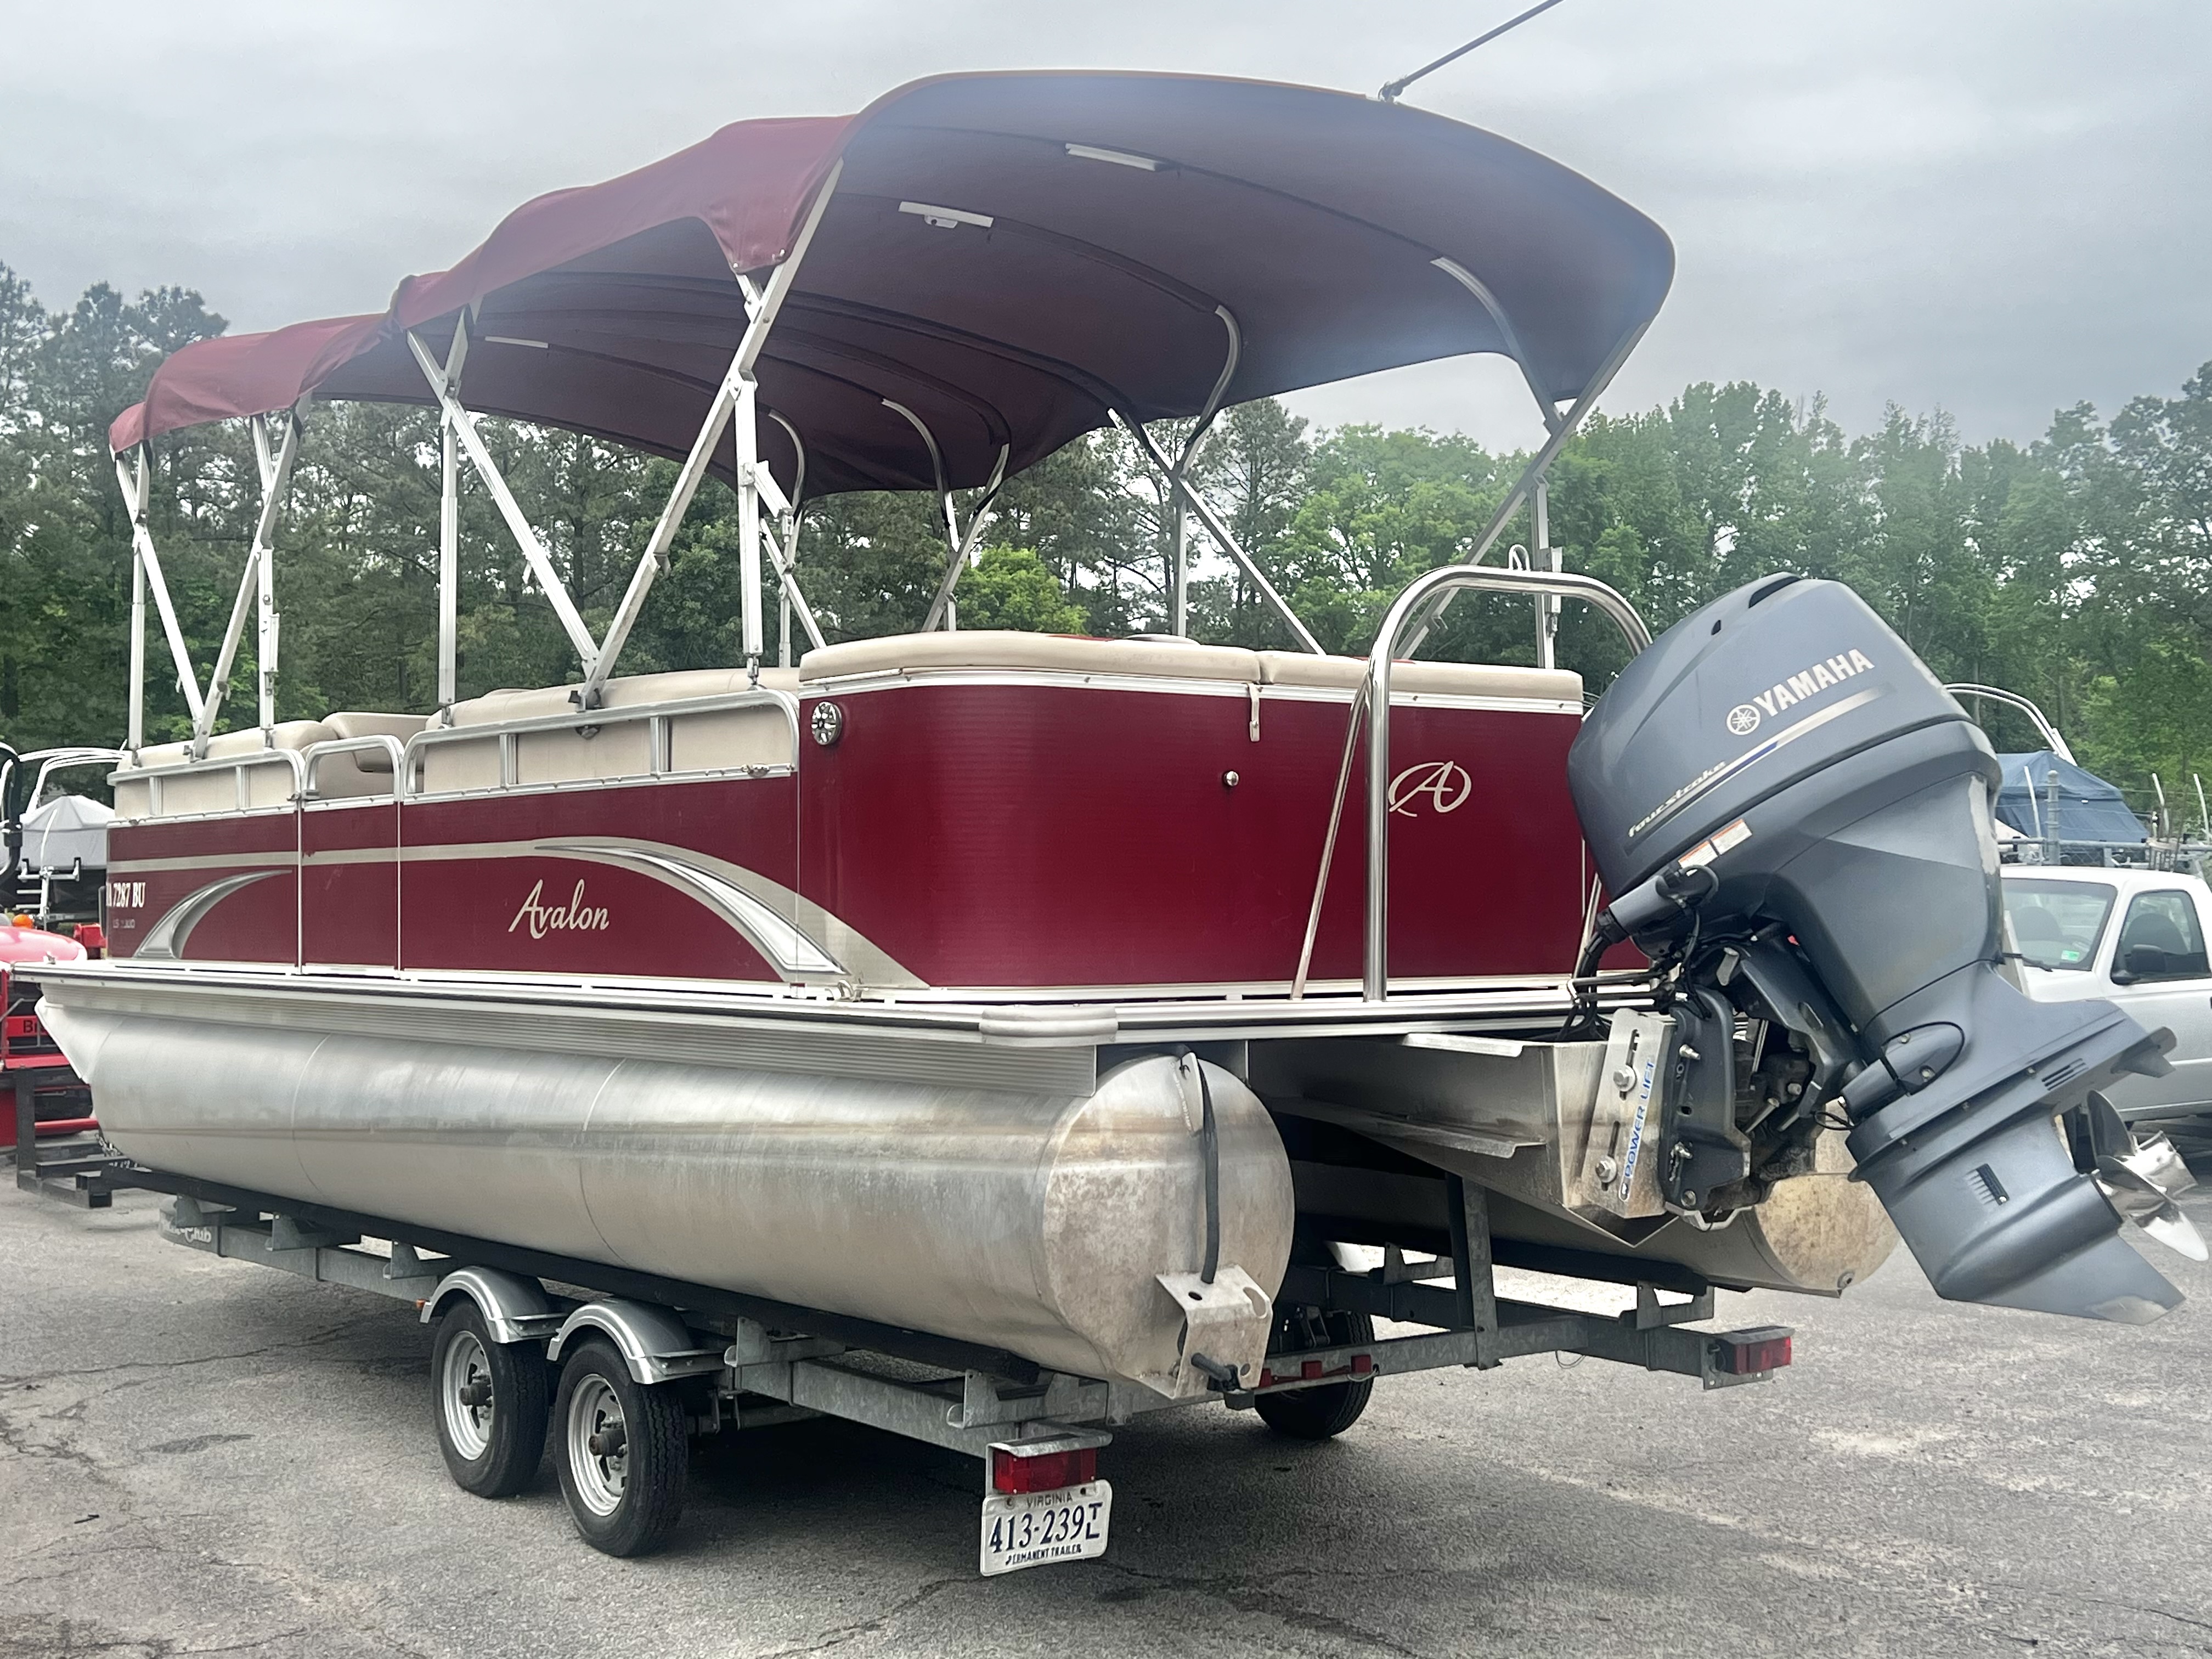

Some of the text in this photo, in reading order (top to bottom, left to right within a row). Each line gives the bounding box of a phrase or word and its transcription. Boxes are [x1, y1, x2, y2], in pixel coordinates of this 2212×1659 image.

[1753, 648, 1875, 716] YAMAHA
[132, 882, 146, 908] BU
[508, 879, 610, 939] Avalon
[1624, 1062, 1655, 1177] POWER LIFT
[1026, 1492, 1073, 1508] VIRGINIA
[989, 1505, 1085, 1554] 413-239
[1005, 1543, 1082, 1565] PERMANENT TRAILER
